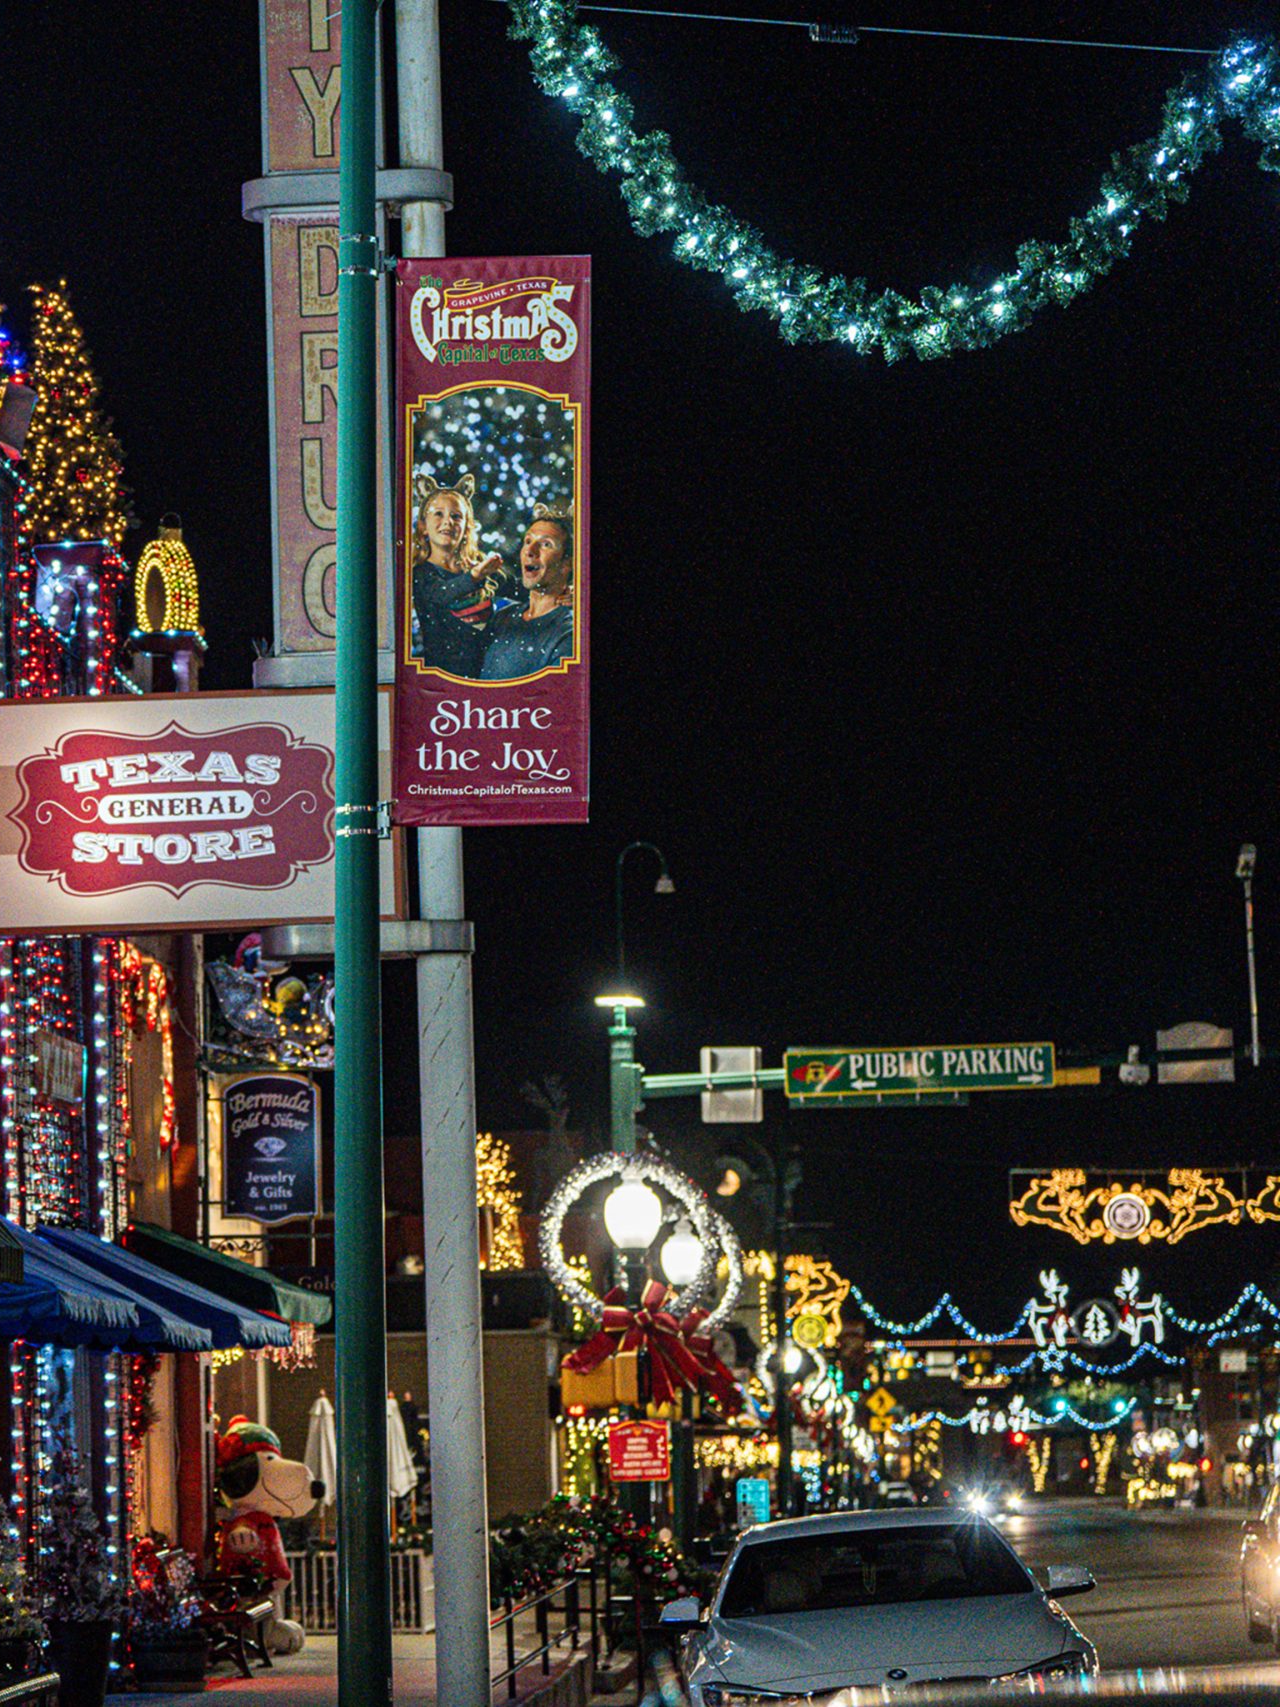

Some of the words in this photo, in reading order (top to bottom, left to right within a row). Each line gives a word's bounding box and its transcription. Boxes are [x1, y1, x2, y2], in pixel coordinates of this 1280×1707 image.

[451, 288, 507, 307] GRAPEVINE
[516, 281, 548, 291] TEXAS
[437, 341, 489, 366] Capital
[499, 343, 546, 365] Texas
[430, 700, 552, 737] Share
[60, 751, 282, 794] TEXAS
[416, 741, 480, 771] the
[491, 742, 571, 781] Joy
[408, 784, 572, 798] ChristmasCapitalofTexas.com
[108, 795, 245, 820] GENERAL
[71, 824, 276, 865] STORE
[849, 1051, 935, 1079] PUBLIC
[941, 1047, 1045, 1076] PARKING
[229, 1090, 311, 1114] Bermuda
[231, 1112, 261, 1138] Gold
[270, 1112, 309, 1132] Silver
[245, 1170, 297, 1186] Jewelry
[249, 1186, 260, 1199] &
[263, 1186, 293, 1199] Gifts
